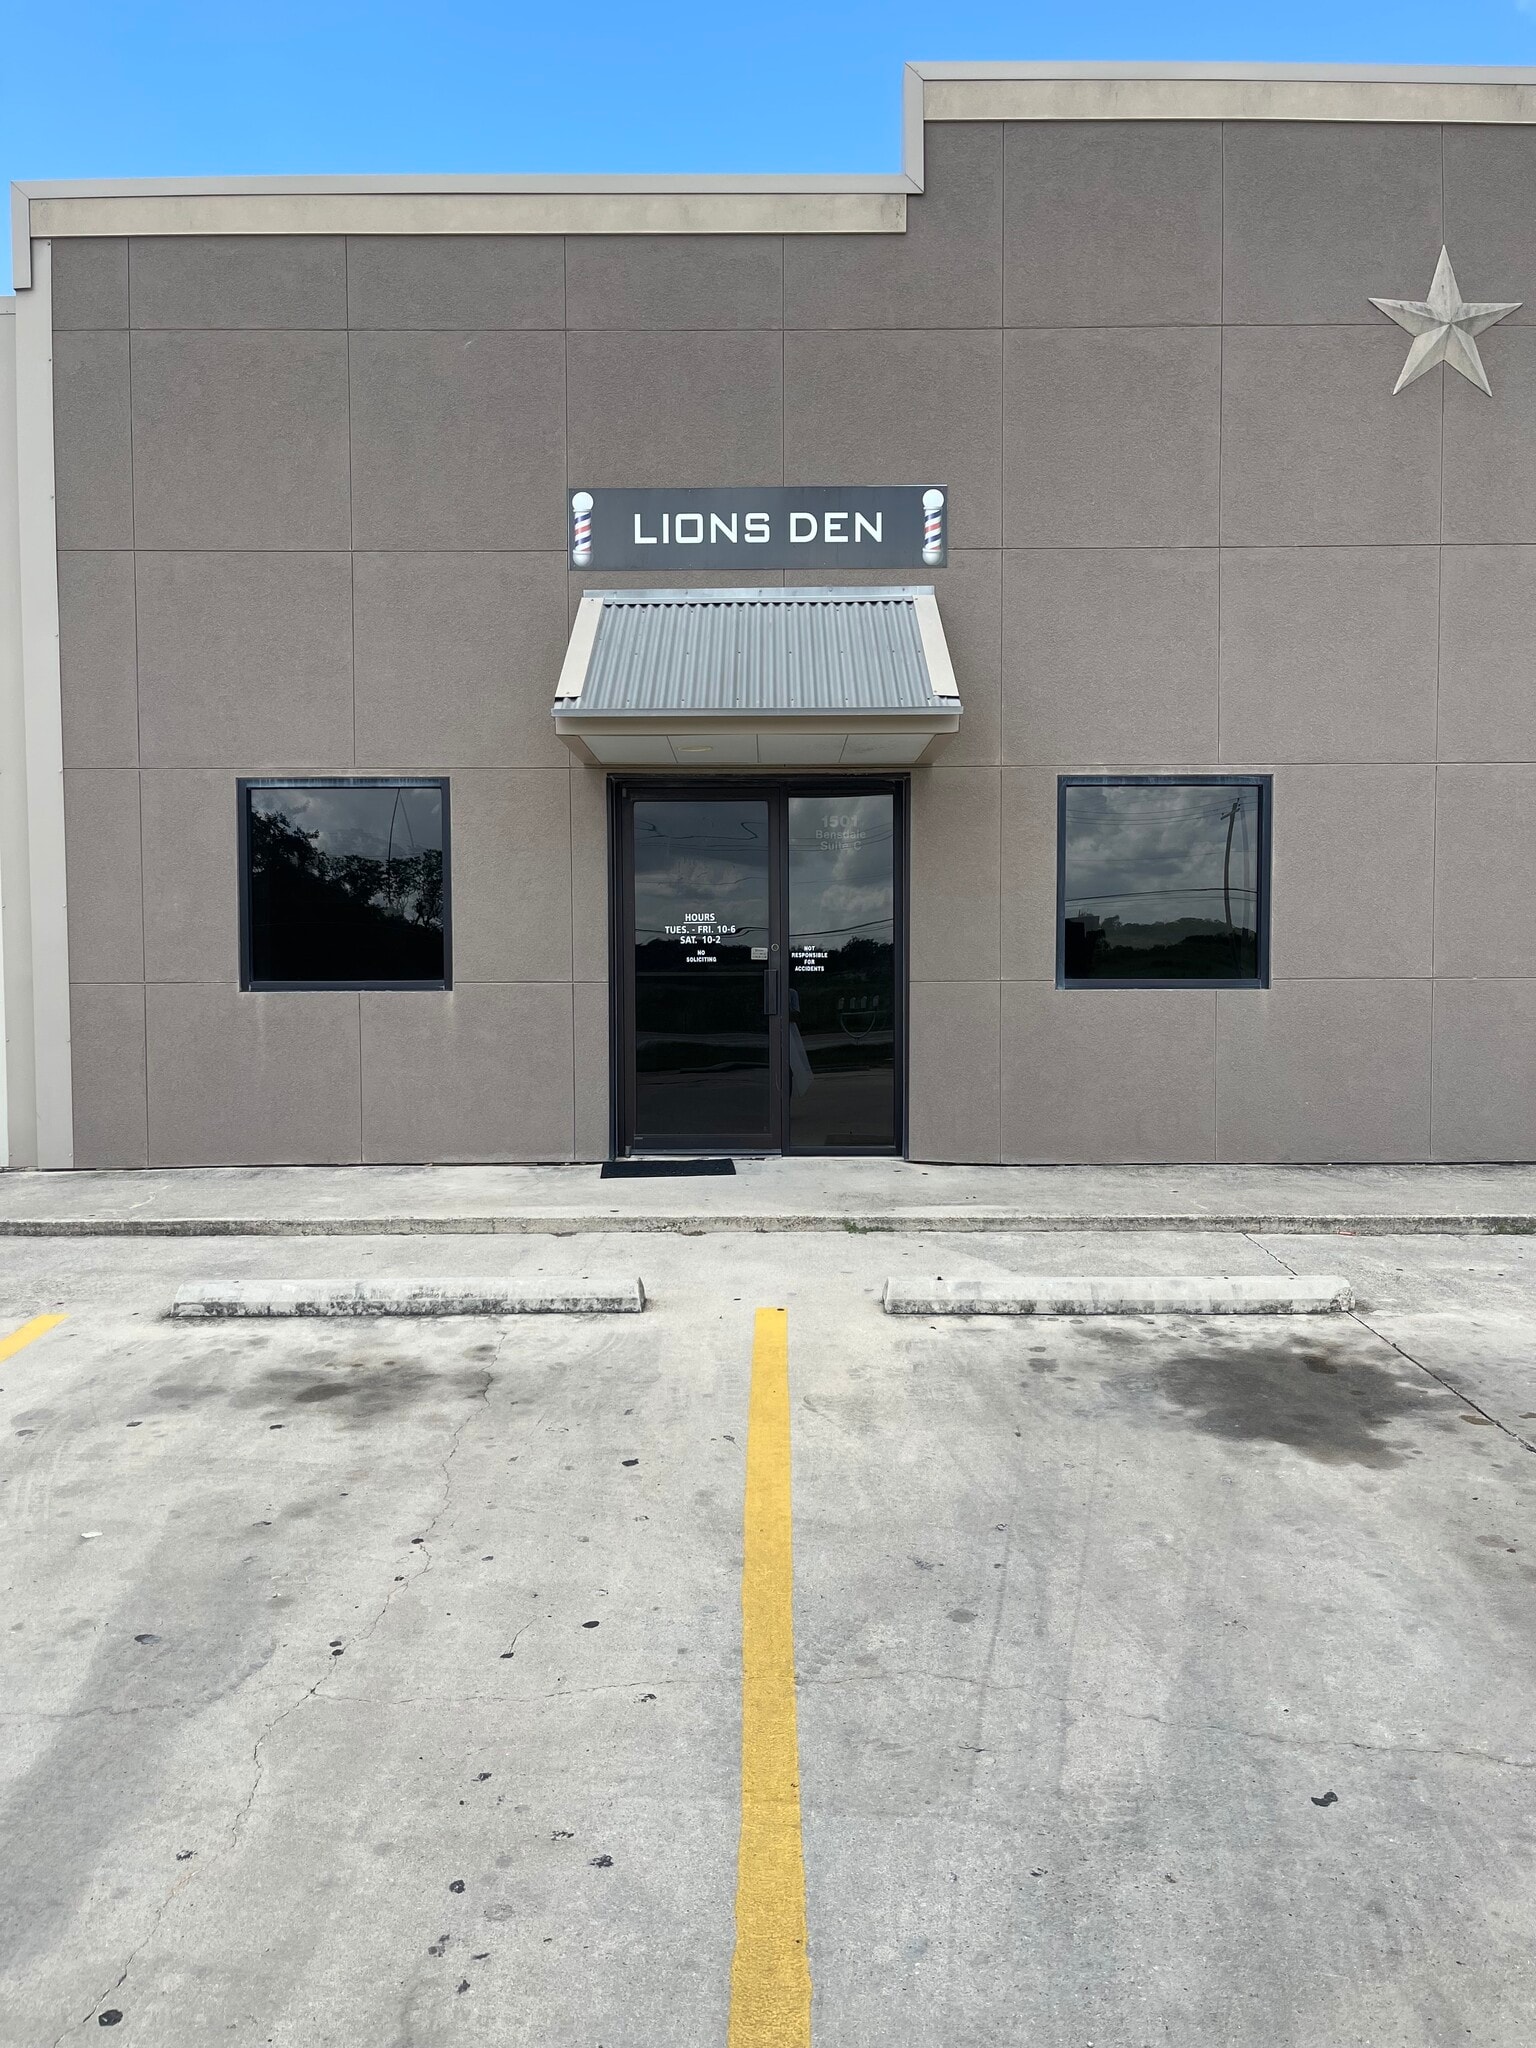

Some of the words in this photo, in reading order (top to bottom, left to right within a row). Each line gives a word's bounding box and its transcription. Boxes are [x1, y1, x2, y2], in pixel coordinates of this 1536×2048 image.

[634, 511, 770, 545] LIONS
[789, 511, 883, 543] DEN
[821, 815, 858, 828] 1501
[820, 841, 849, 851] Suite
[684, 913, 716, 922] HOURS
[665, 925, 690, 934] TUES.
[697, 925, 714, 934] FRI.
[717, 925, 736, 934] 10-6
[680, 936, 698, 945] SAT.
[702, 935, 721, 944] 10-2
